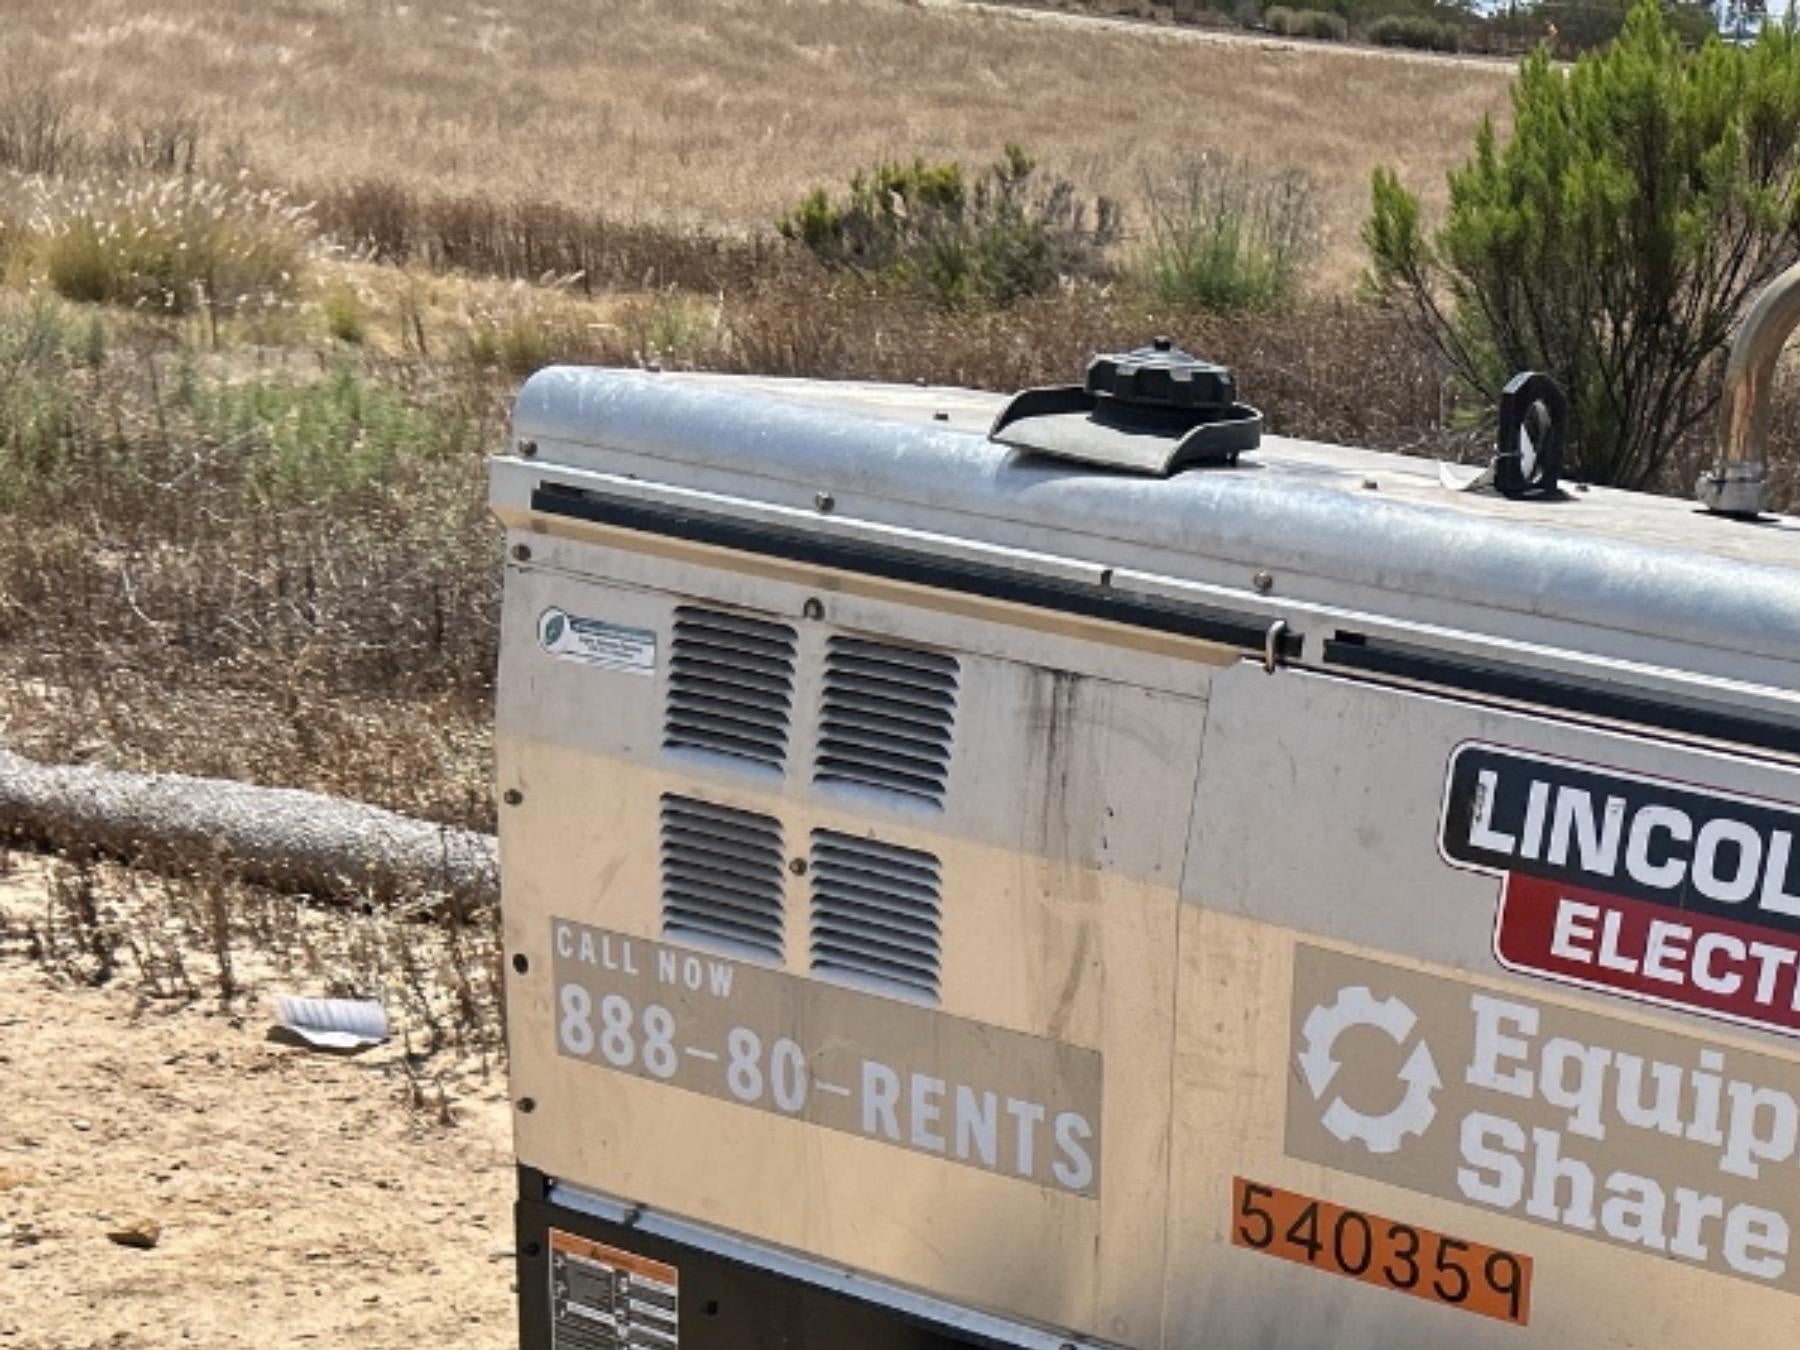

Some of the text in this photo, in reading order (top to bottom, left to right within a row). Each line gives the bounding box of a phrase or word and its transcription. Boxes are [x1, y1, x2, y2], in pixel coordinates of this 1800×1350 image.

[556, 925, 735, 999] CALL NOW
[558, 981, 1095, 1190] 888-80-RENTS
[1238, 1183, 1522, 1318] 540359
[1456, 1109, 1789, 1281] Share
